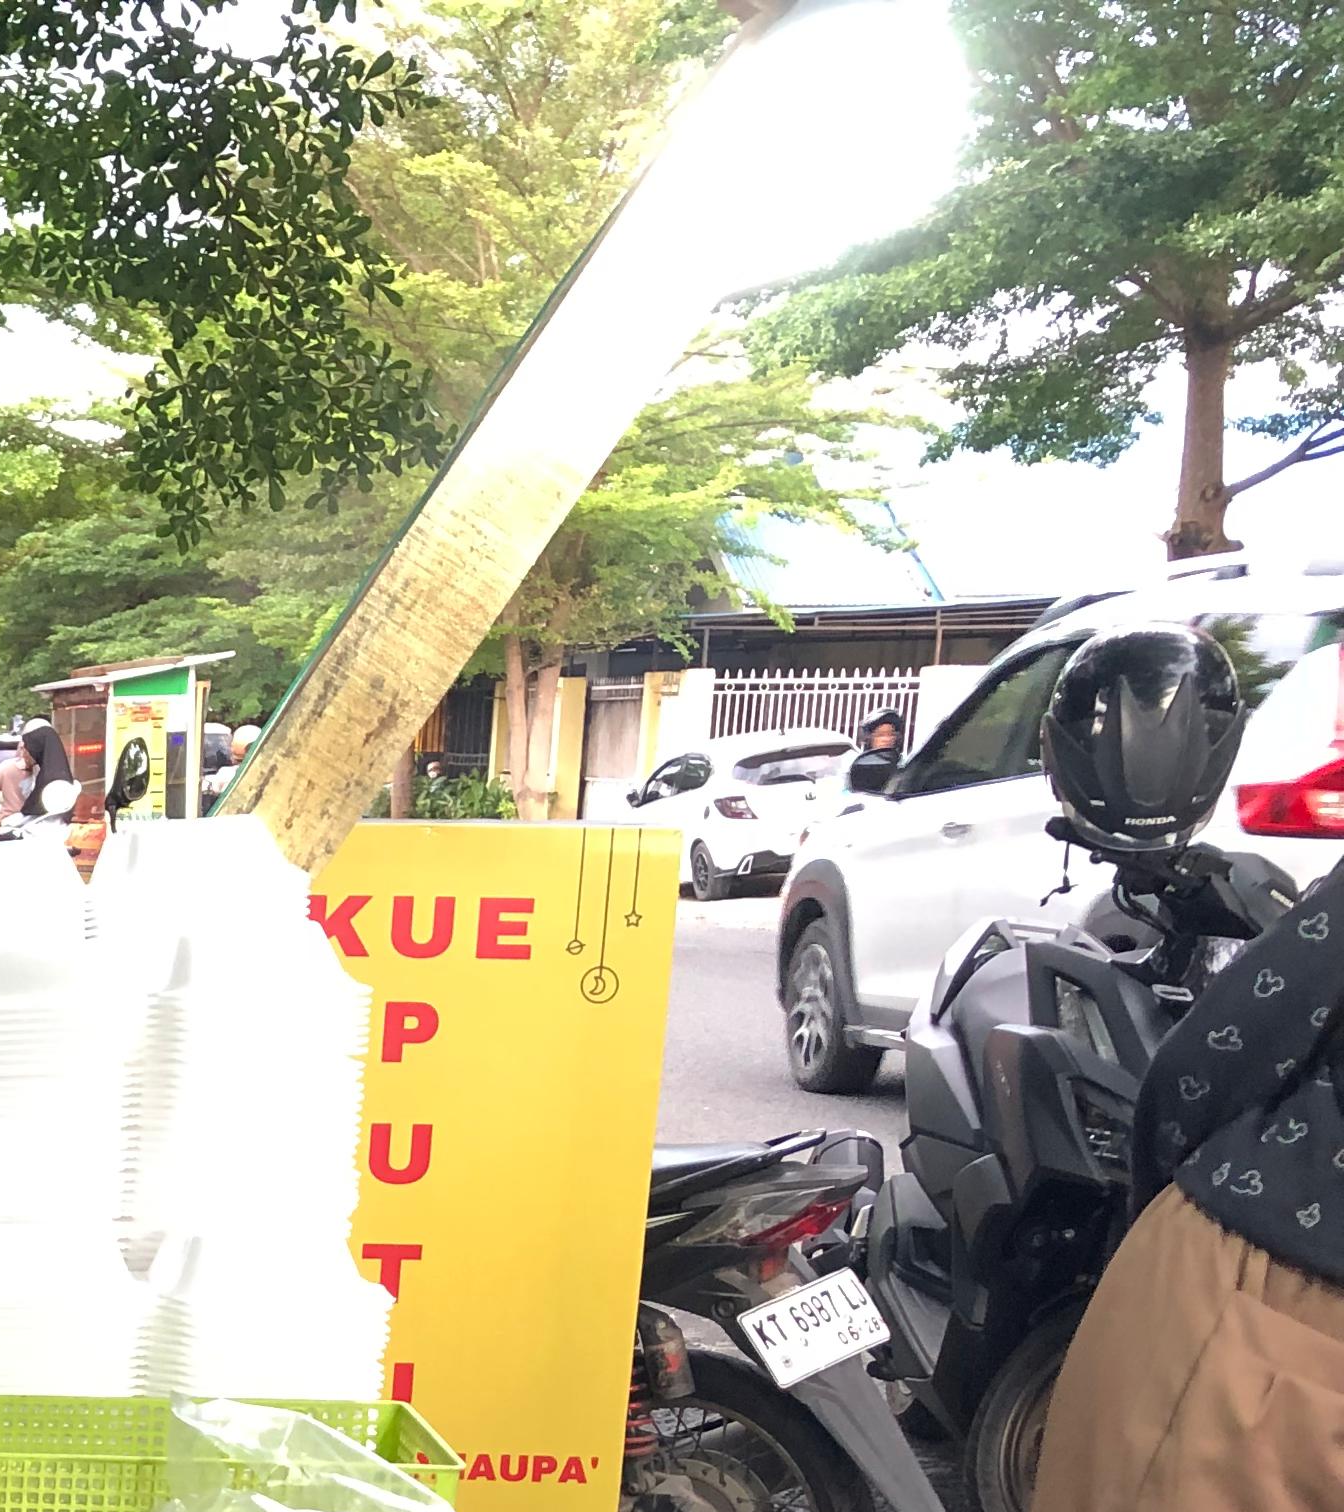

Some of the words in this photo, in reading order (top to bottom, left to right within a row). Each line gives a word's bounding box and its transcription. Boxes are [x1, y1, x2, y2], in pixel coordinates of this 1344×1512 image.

[1124, 815, 1177, 827] HONDA
[308, 894, 536, 959] KUE
[752, 1313, 788, 1350] KT
[789, 1290, 841, 1333] 6987
[838, 1278, 868, 1311] LJ
[458, 1452, 600, 1485] AUPA'
